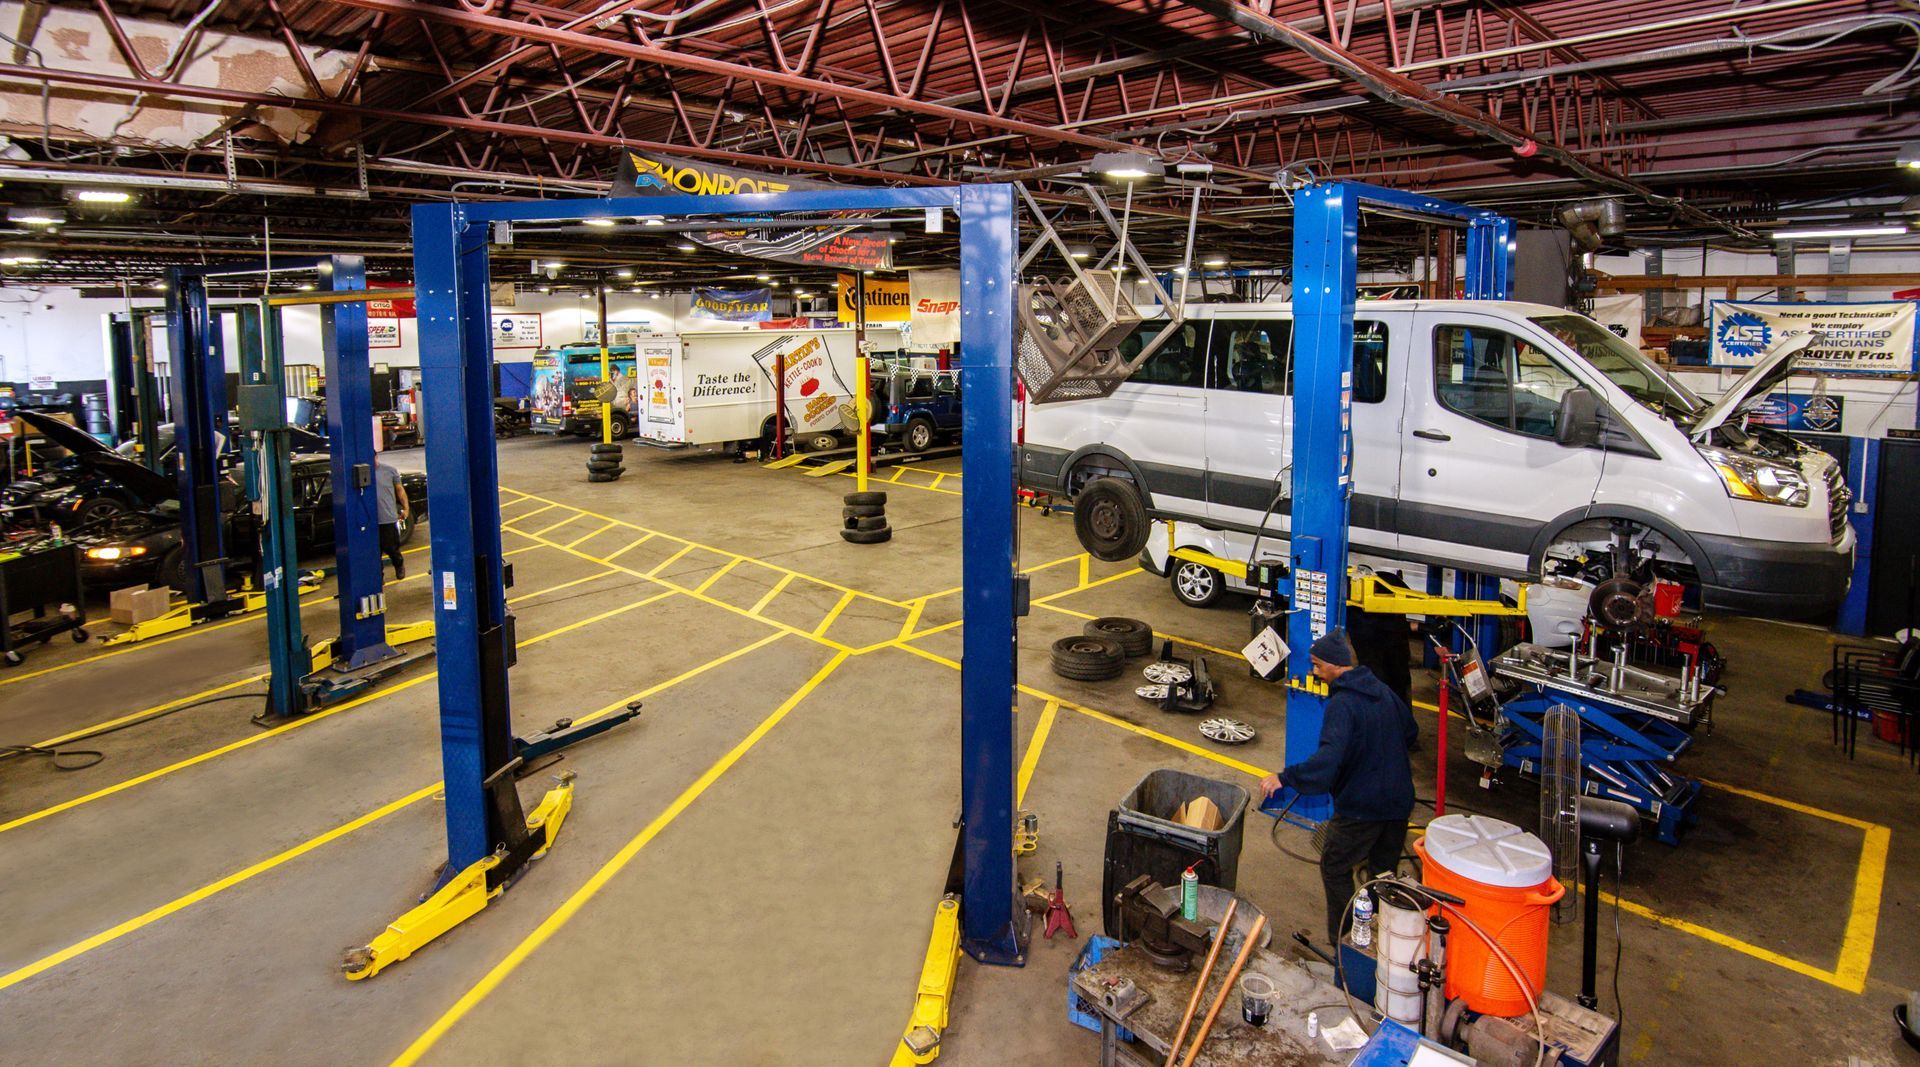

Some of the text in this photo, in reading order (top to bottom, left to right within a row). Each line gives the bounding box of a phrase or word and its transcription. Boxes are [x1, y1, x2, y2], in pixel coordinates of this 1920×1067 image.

[842, 236, 861, 246] New
[862, 237, 887, 248] Breed
[803, 253, 823, 262] New
[824, 254, 849, 264] Breed
[1811, 312, 1837, 320] good
[1838, 311, 1898, 319] Technician?
[1827, 322, 1865, 330] employ
[1722, 325, 1764, 341] ASE
[1858, 351, 1894, 360] Pros
[697, 372, 751, 385] Taste the
[692, 383, 757, 398] Difference!
[803, 395, 837, 423] COOKED
